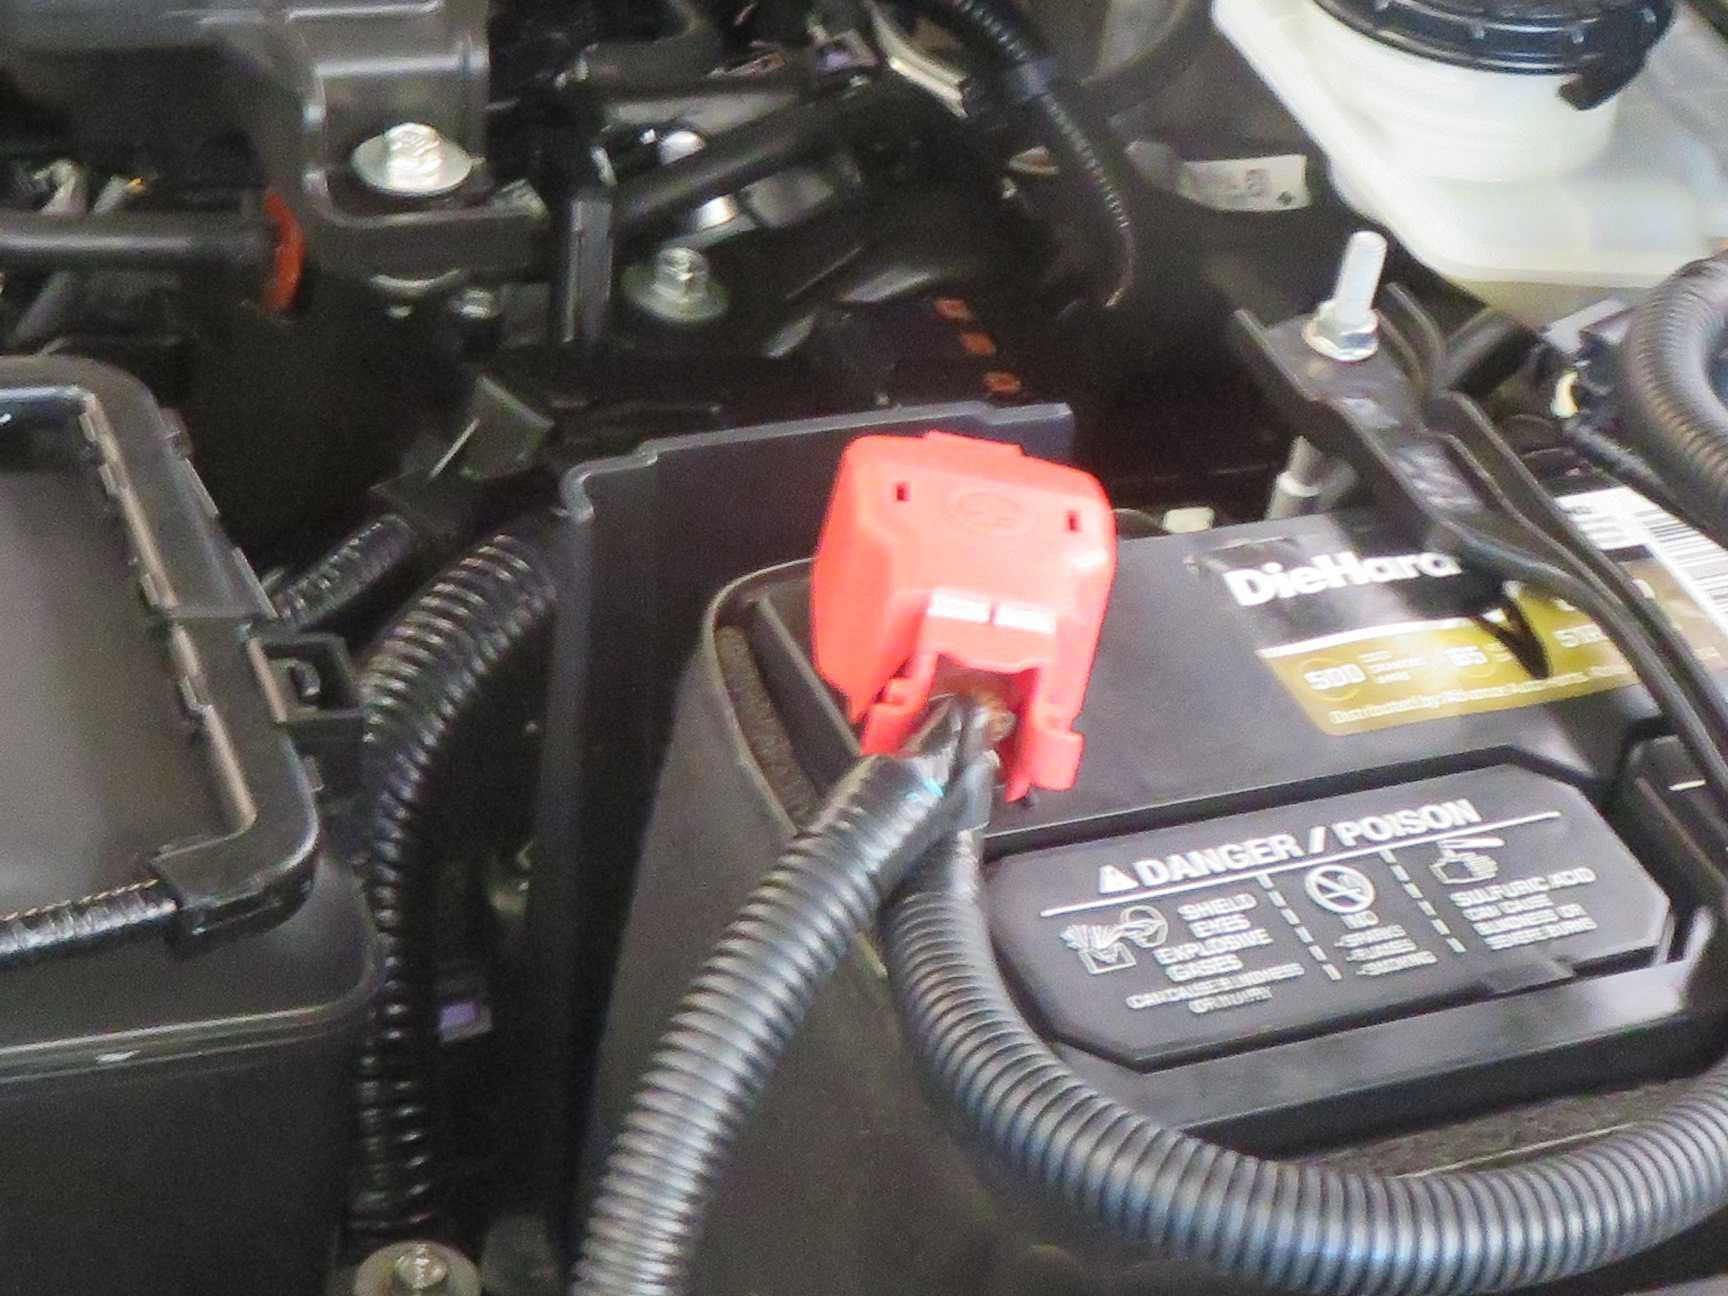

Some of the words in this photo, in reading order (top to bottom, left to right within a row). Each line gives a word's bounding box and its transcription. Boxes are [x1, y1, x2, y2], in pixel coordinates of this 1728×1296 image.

[1132, 833, 1304, 887] DANGER
[1331, 798, 1482, 847] POISON
[1450, 876, 1550, 907] SULFURIC
[1548, 867, 1597, 889] ACID
[1177, 893, 1257, 921] SHIELD
[1189, 913, 1251, 939] EYES
[1152, 928, 1273, 965] EXPLOSIVE
